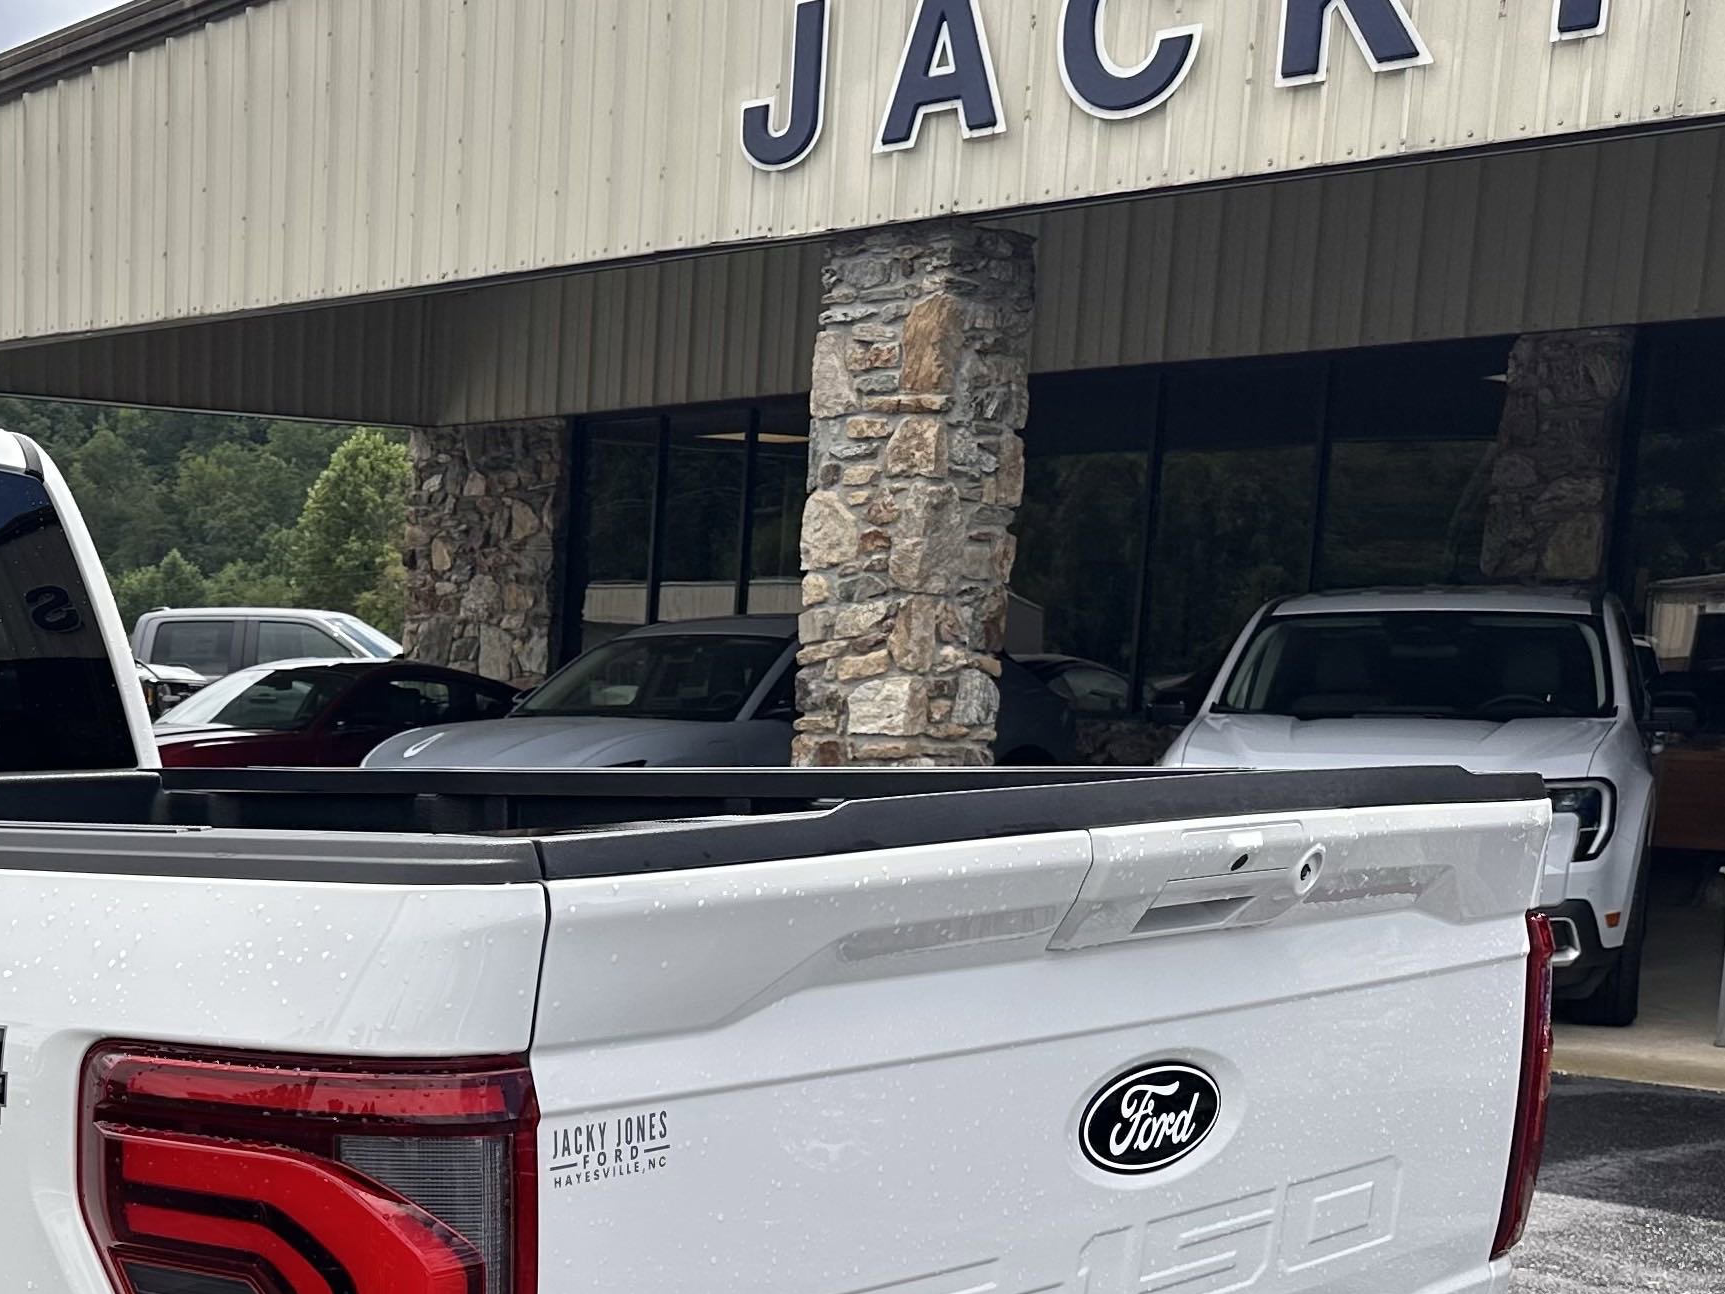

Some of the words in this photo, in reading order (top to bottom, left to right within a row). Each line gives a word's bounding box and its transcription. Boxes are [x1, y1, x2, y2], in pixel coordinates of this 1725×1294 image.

[740, 0, 1609, 171] JAC
[552, 1121, 607, 1160] JACKY
[616, 1110, 668, 1148] JONES
[1109, 1080, 1200, 1156] Ford
[583, 1145, 639, 1170] FORD
